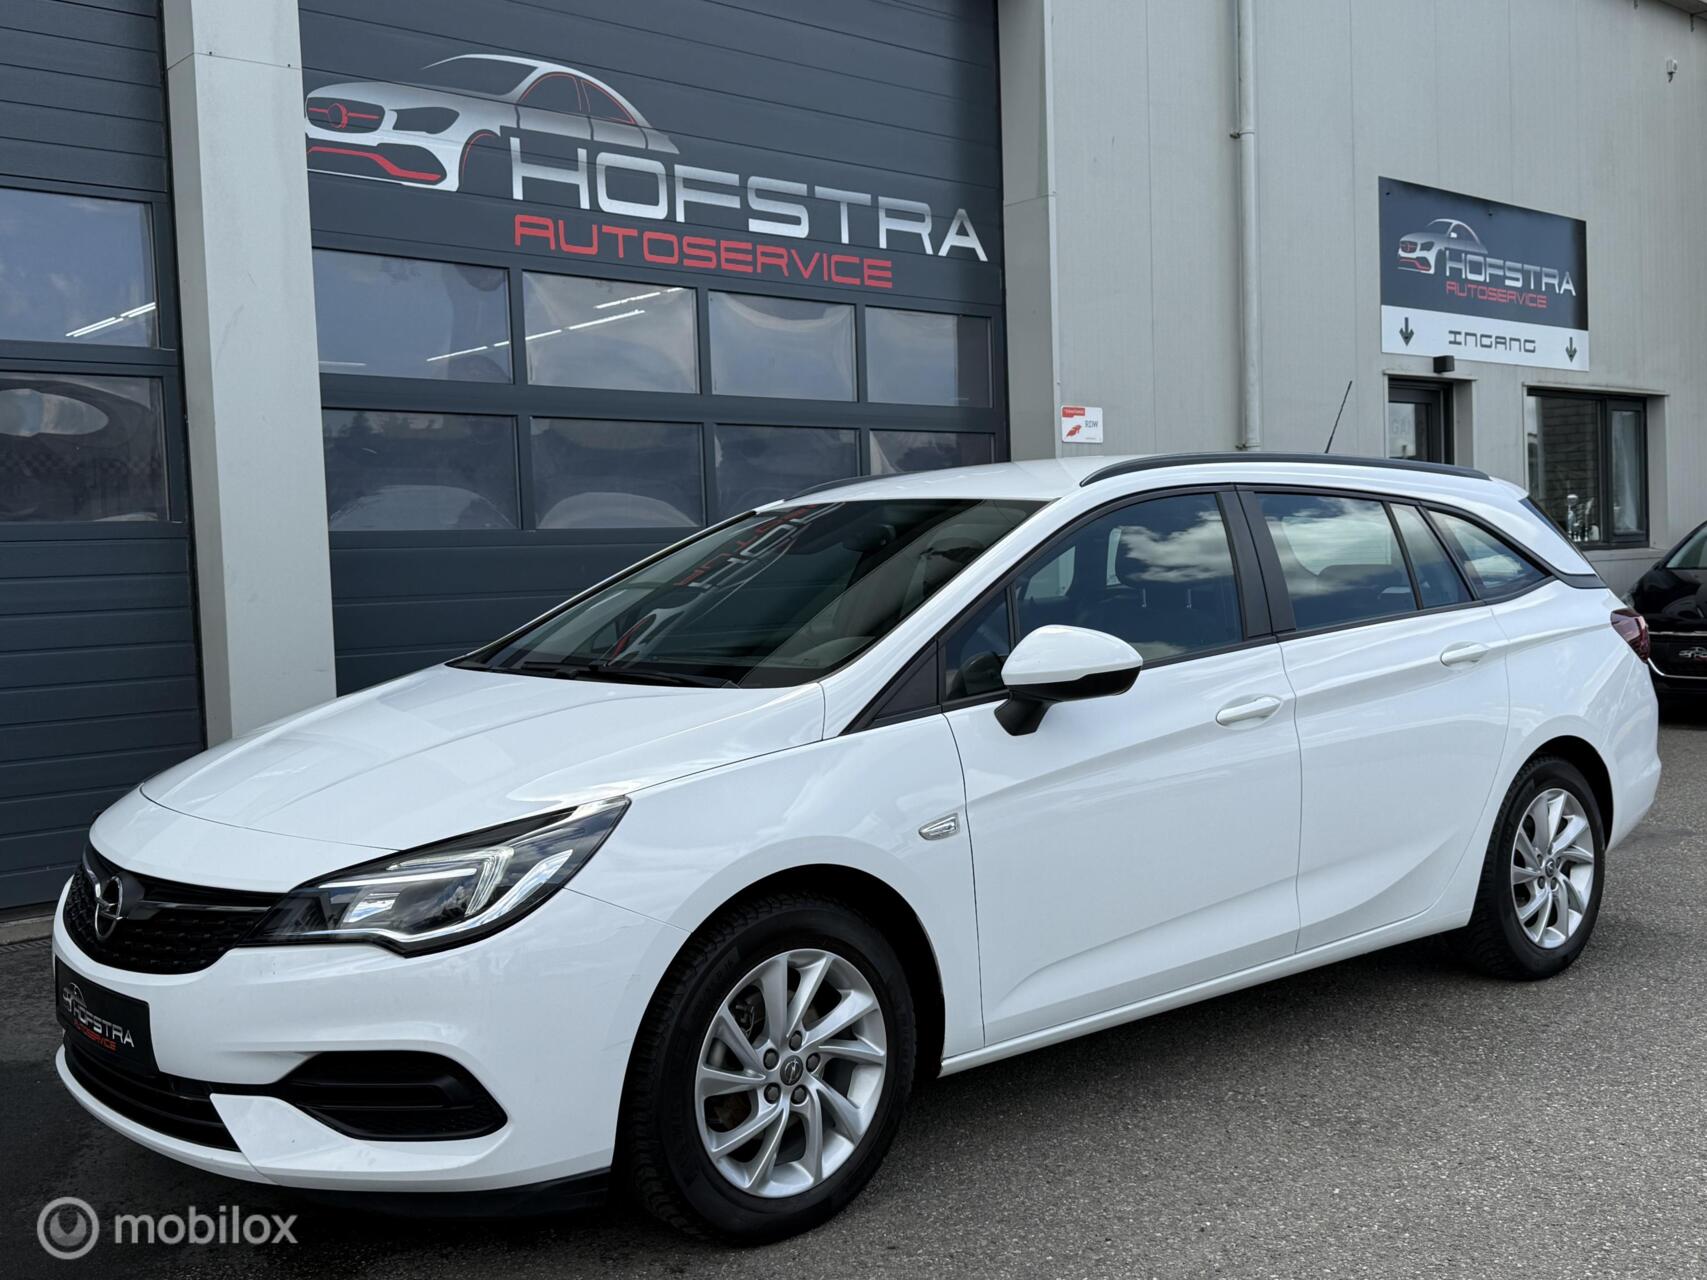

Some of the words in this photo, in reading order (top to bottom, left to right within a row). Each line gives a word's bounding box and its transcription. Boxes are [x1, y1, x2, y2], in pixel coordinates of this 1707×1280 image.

[510, 136, 989, 262] HOFSTRA
[513, 214, 893, 289] AUTOSERVICE
[1446, 249, 1577, 296] HOFSTRA
[1446, 281, 1548, 309] AUTOSERVICE
[1448, 329, 1537, 353] INGANG
[73, 1001, 135, 1048] HOFSTRA
